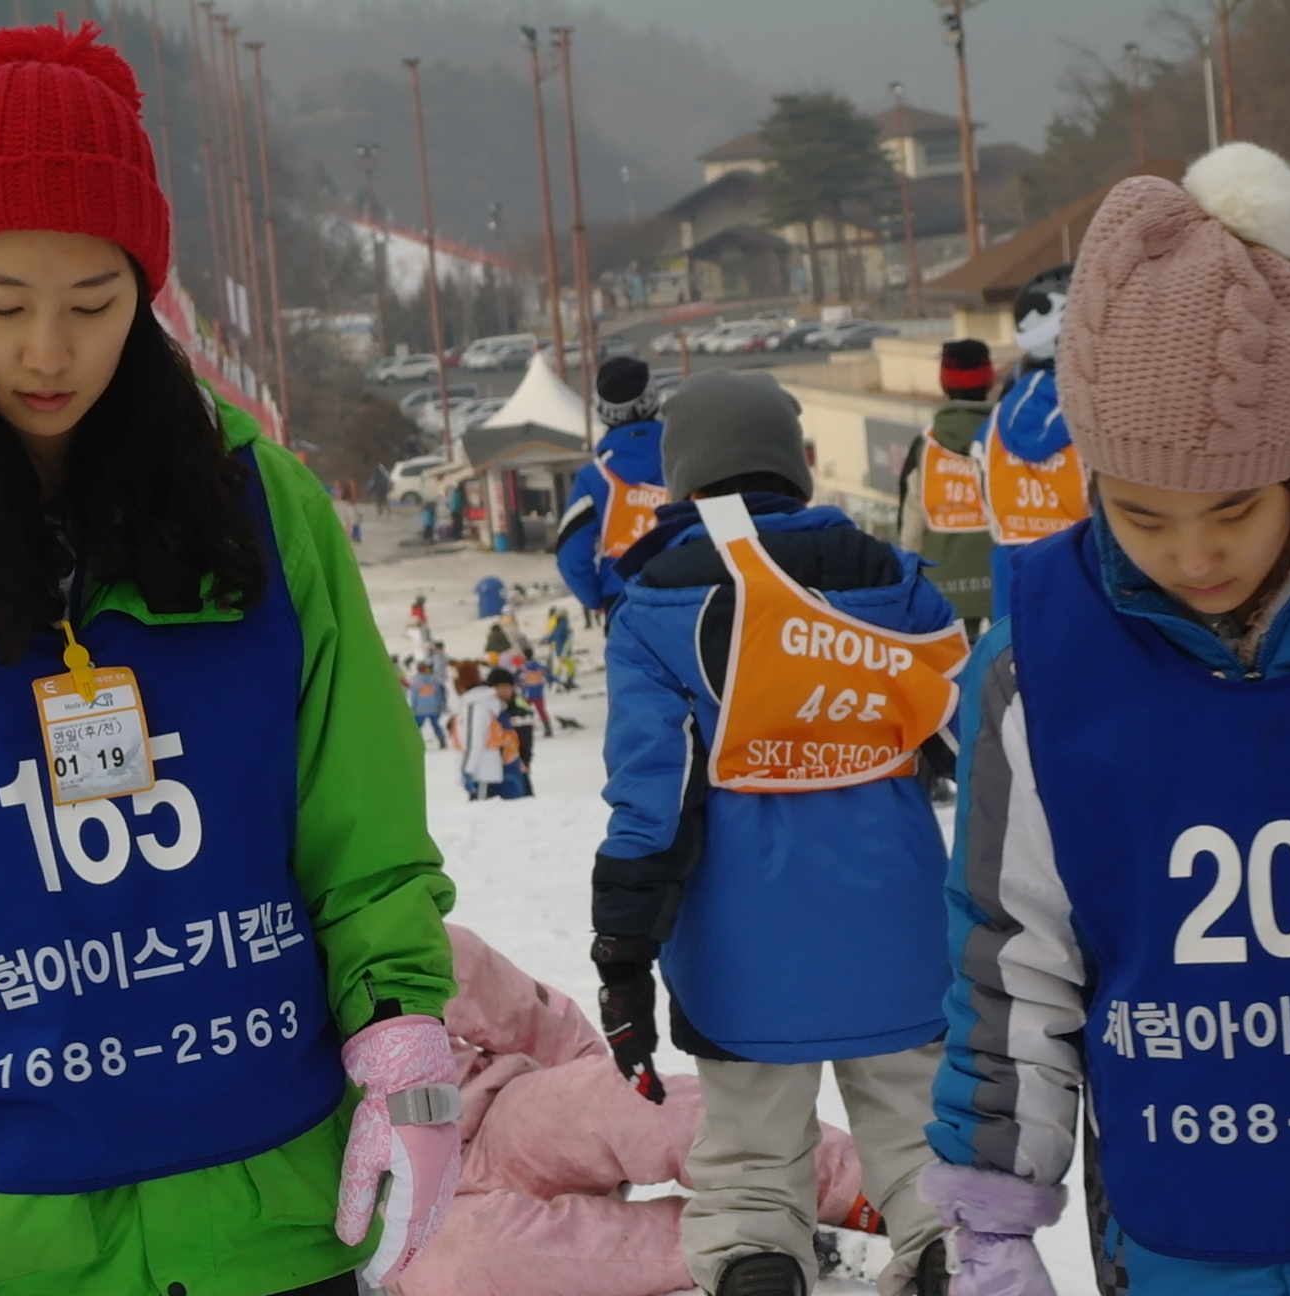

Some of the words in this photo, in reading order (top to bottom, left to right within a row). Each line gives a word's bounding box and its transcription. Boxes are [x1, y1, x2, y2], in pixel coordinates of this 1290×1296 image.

[781, 616, 914, 678] GROUP
[54, 754, 79, 778] 01
[97, 747, 124, 770] 19
[747, 739, 794, 767] SKI
